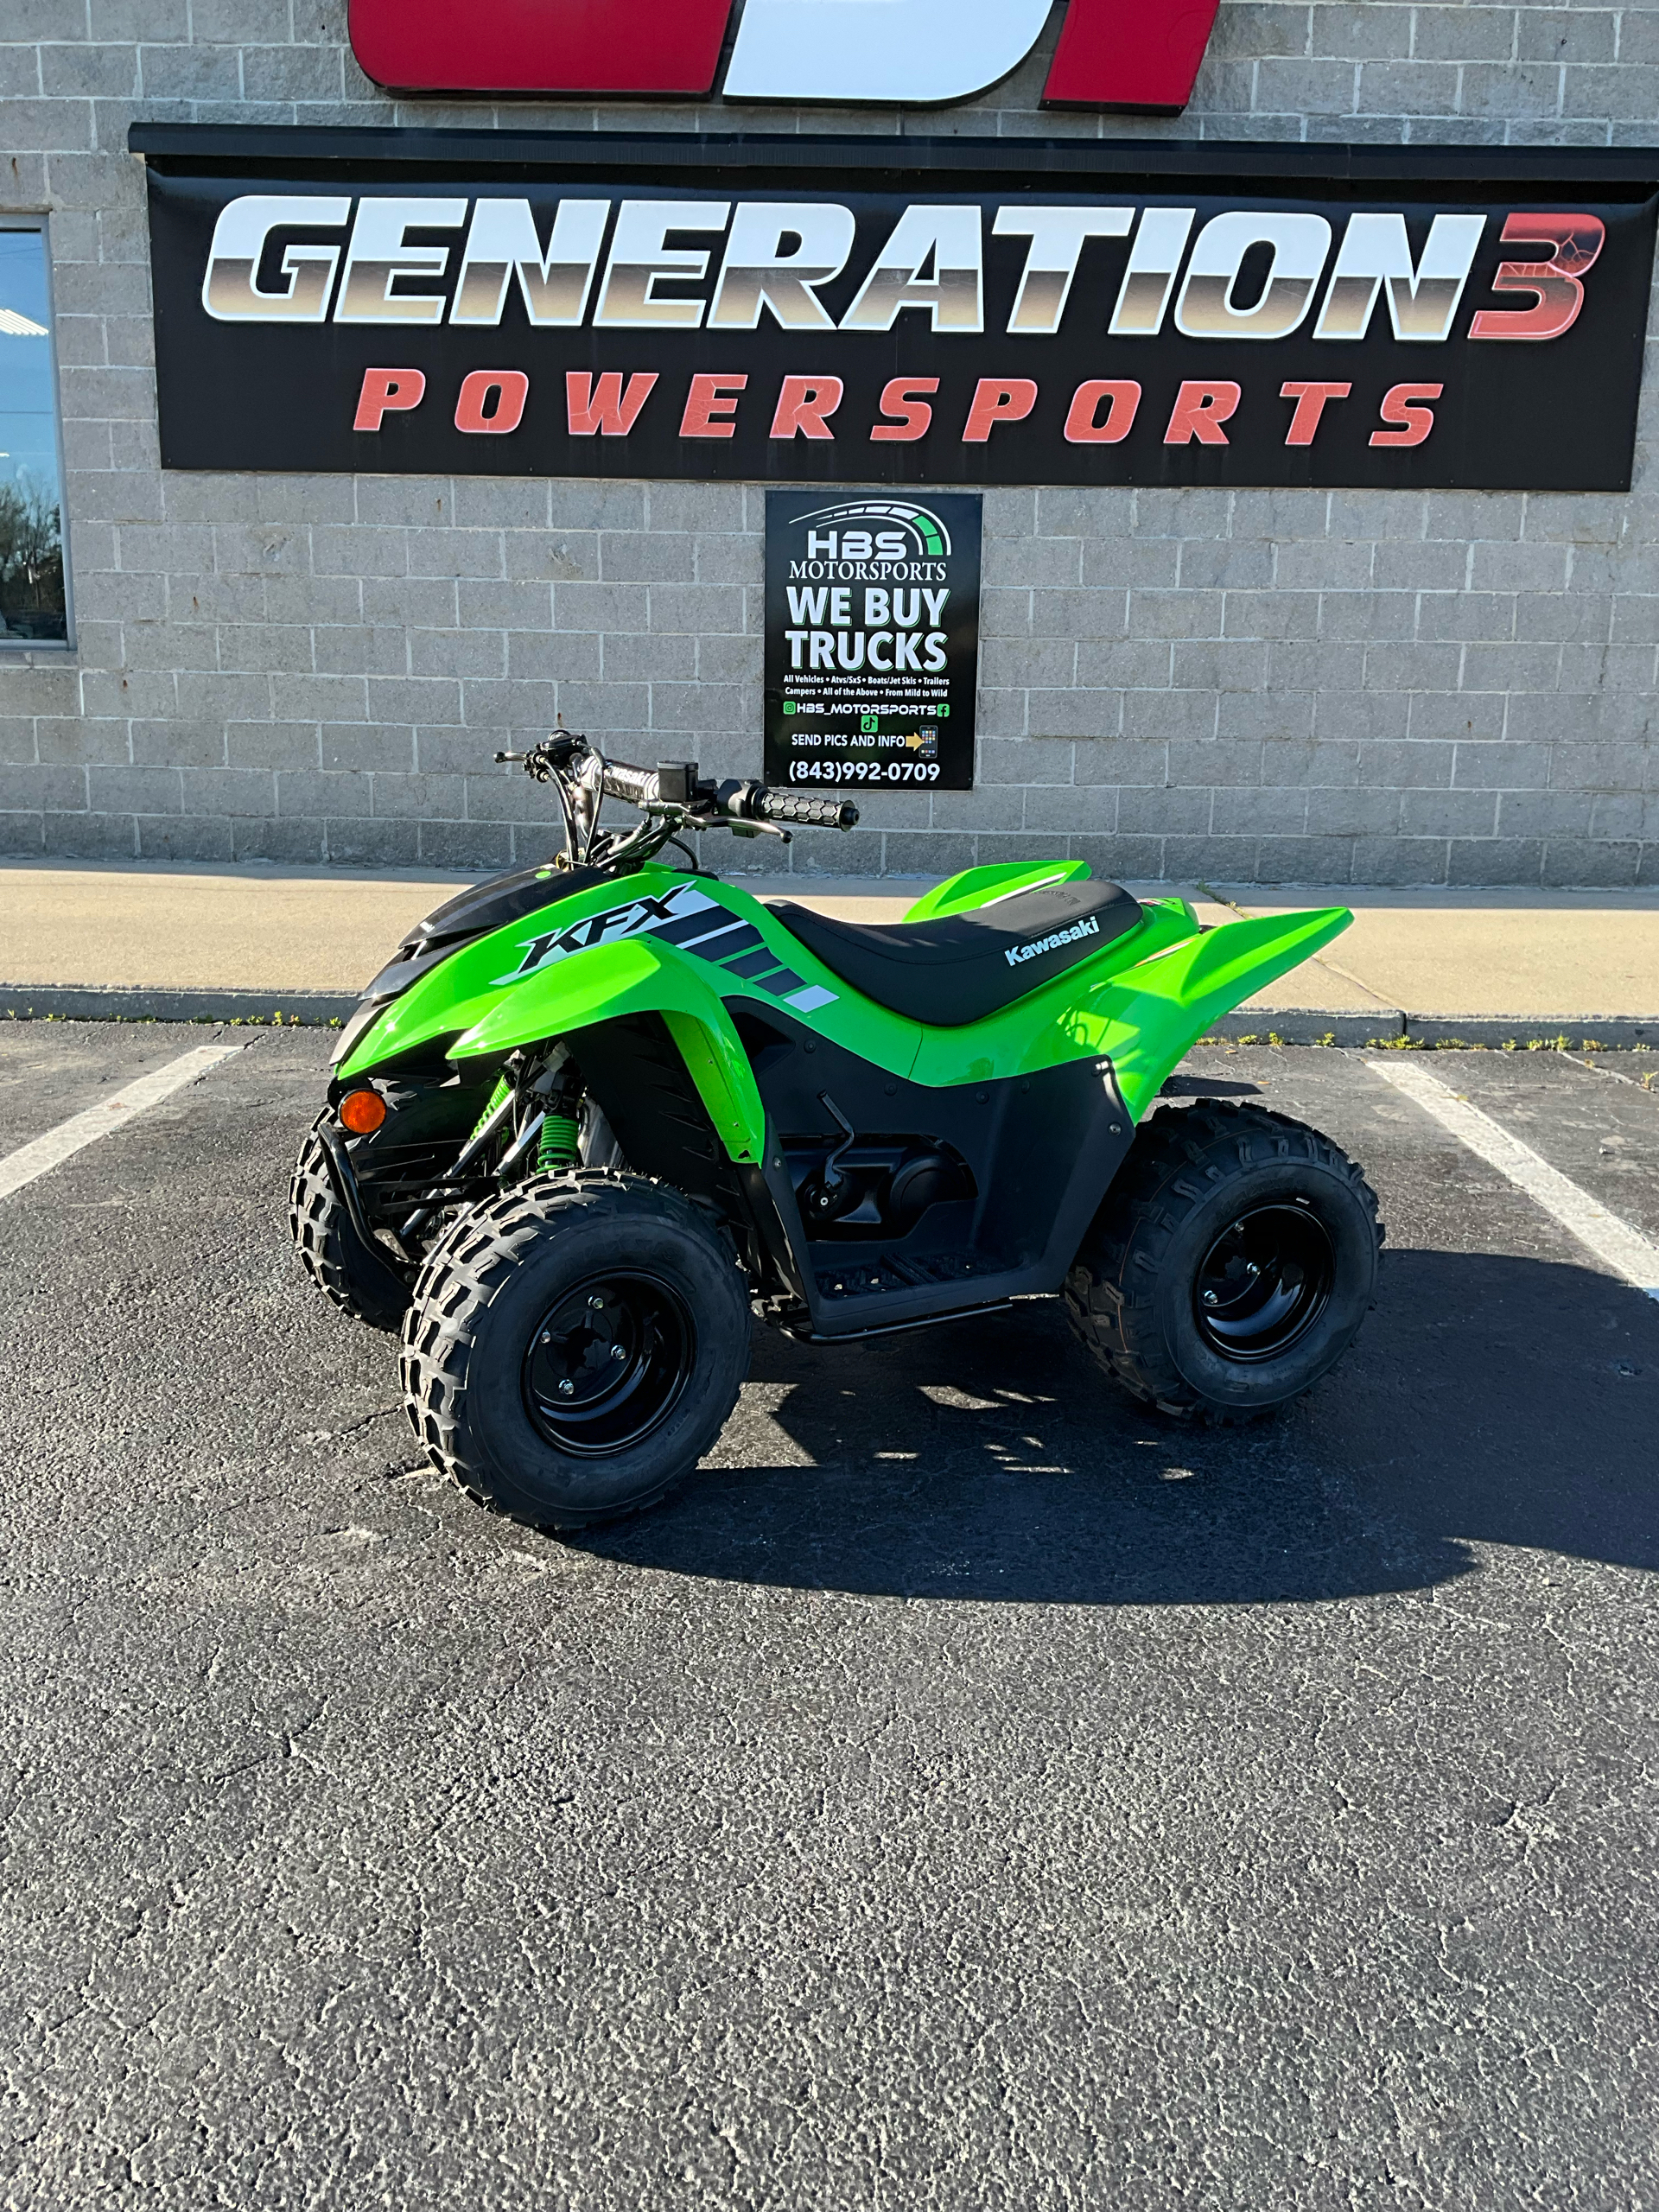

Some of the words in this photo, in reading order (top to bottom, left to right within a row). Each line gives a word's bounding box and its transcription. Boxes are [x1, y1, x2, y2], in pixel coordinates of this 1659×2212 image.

[353, 368, 1443, 446] POWERSPORTS
[808, 531, 906, 560] HBS
[789, 561, 946, 581] MOTORSPORTS
[786, 587, 852, 626] WE
[865, 588, 950, 627] BUY
[785, 631, 948, 671] TRUCKS
[785, 686, 816, 696] Campers
[822, 686, 832, 695] All
[842, 687, 855, 696] the
[855, 687, 878, 696] Above
[904, 688, 920, 696] Mild
[794, 674, 823, 683] Vehicles
[830, 675, 861, 683] Atvs/SxS
[868, 676, 900, 684] Boats/Jet
[901, 676, 916, 684] Skis
[923, 677, 950, 685] Trailers
[797, 702, 937, 715] HBS_MOTORSPORTS
[792, 734, 821, 746] SEND
[824, 734, 848, 746] PICS
[850, 735, 875, 747] AND
[878, 735, 905, 747] INFO
[790, 761, 940, 782] (843)992-0709
[515, 881, 695, 976] KFX
[1004, 915, 1100, 967] Kawasaki
